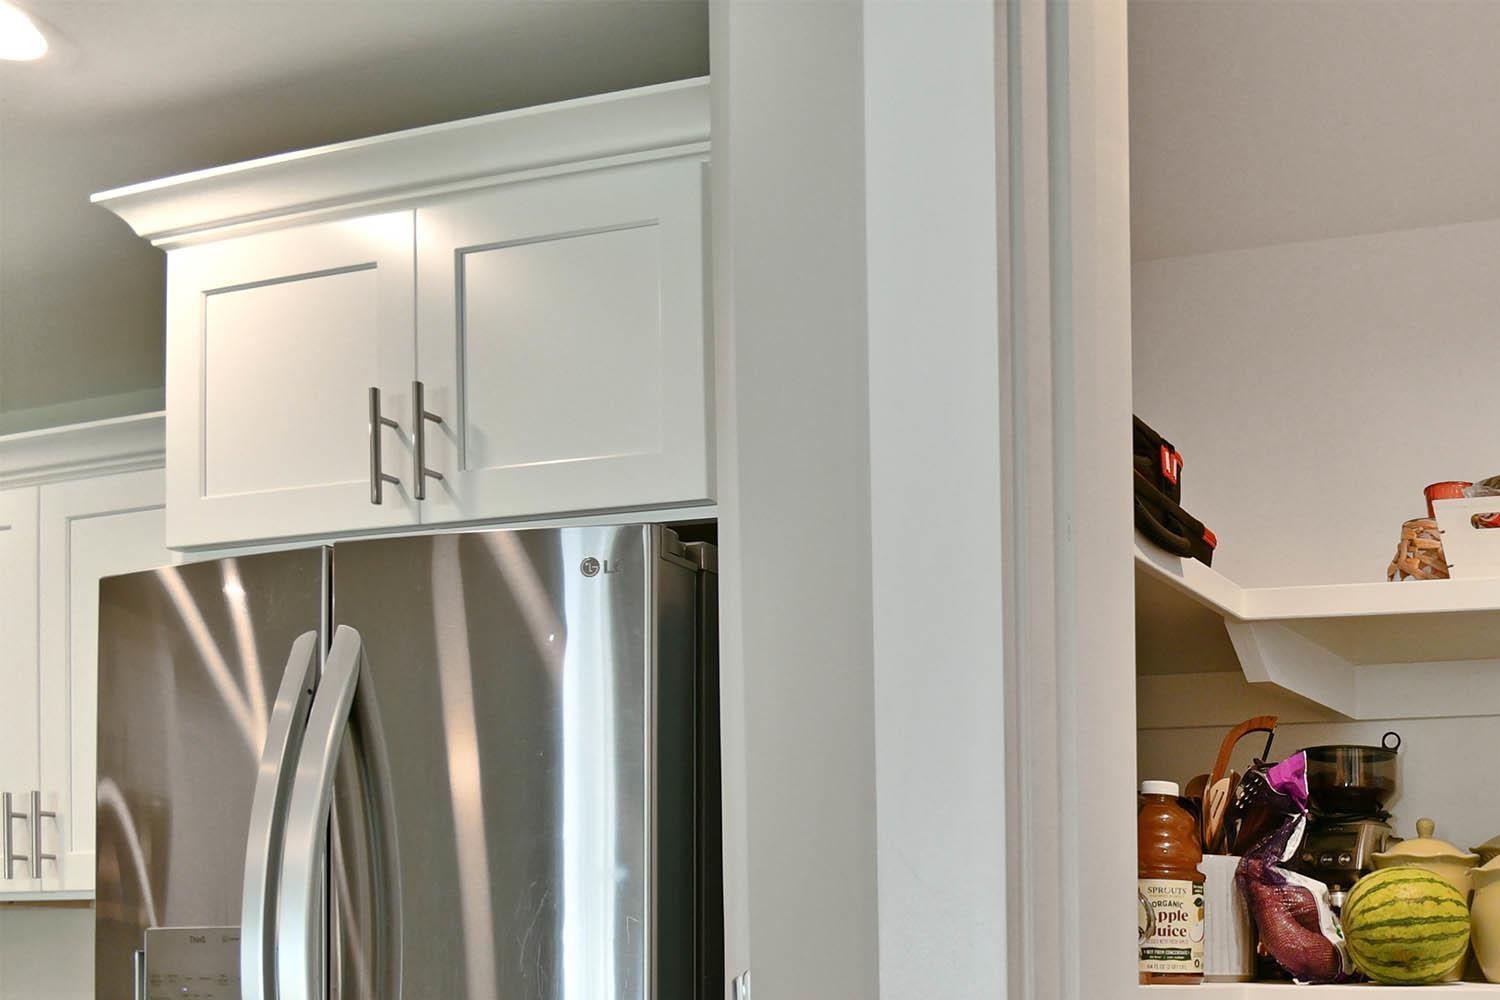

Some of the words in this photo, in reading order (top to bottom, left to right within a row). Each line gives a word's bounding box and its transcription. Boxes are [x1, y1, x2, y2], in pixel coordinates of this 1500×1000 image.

[1147, 886, 1187, 895] SPROUTS
[1151, 900, 1184, 909] ORGANIC
[1157, 910, 1189, 923] pple
